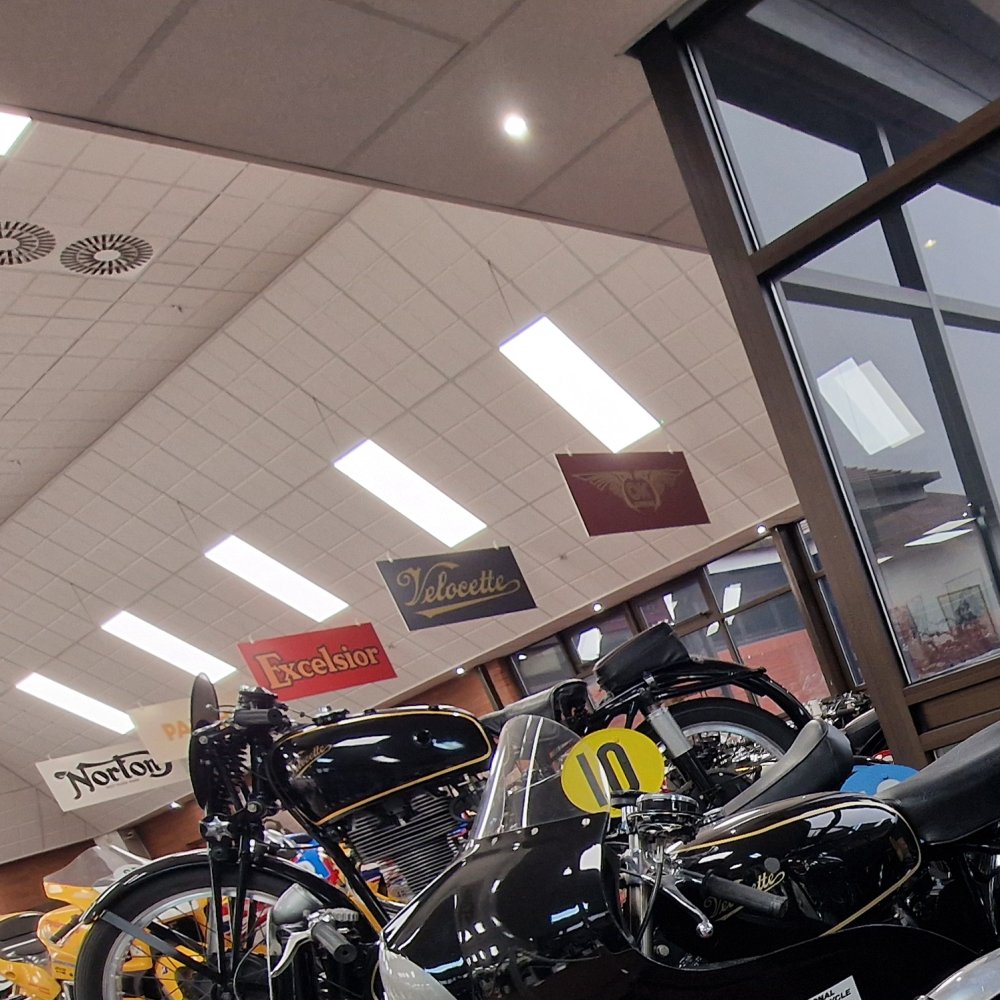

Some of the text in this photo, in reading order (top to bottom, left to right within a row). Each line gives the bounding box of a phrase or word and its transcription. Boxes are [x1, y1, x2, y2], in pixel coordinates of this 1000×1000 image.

[396, 561, 521, 613] Velocette
[255, 644, 380, 691] Excelsior
[54, 750, 173, 799] Norton
